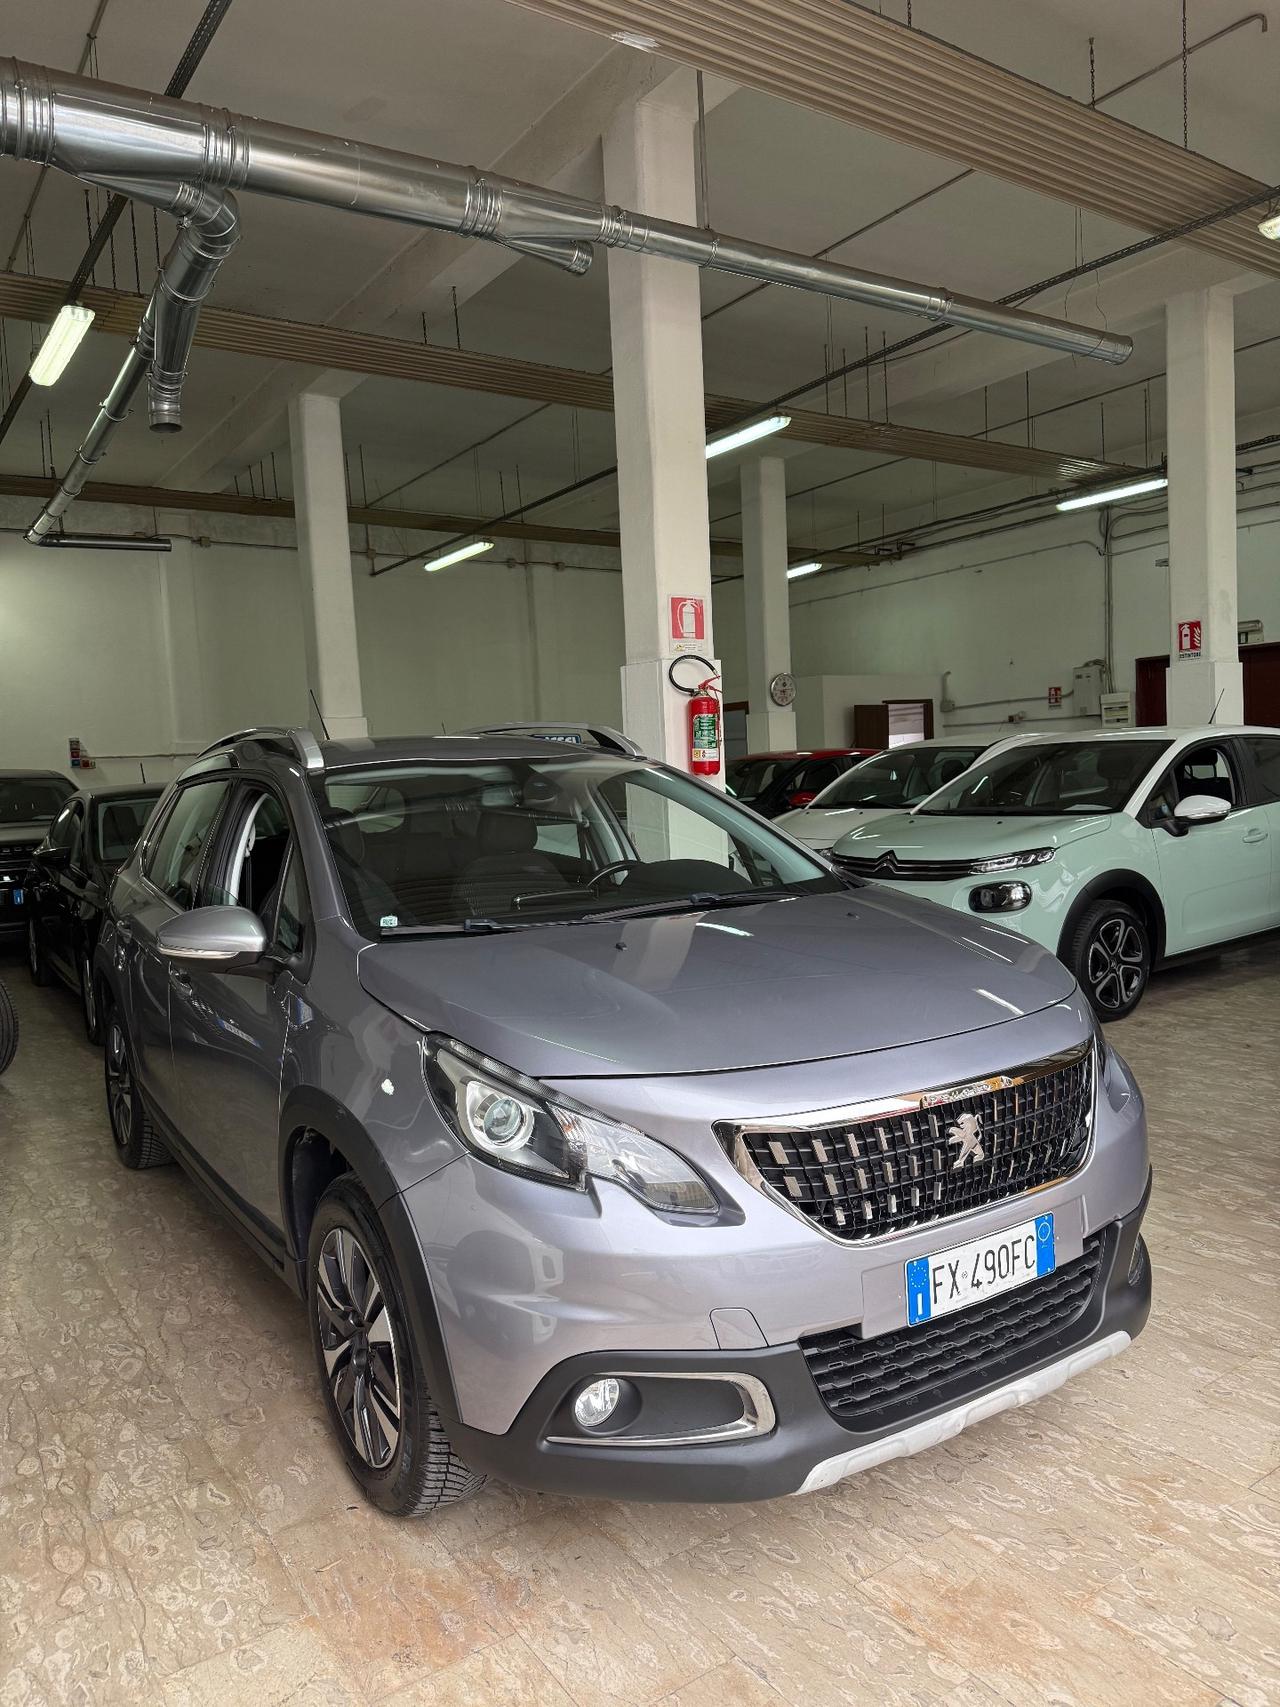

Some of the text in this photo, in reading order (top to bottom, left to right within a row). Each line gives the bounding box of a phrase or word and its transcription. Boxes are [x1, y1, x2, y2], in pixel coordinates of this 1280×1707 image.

[917, 1234, 1036, 1315] I FX 490FC
